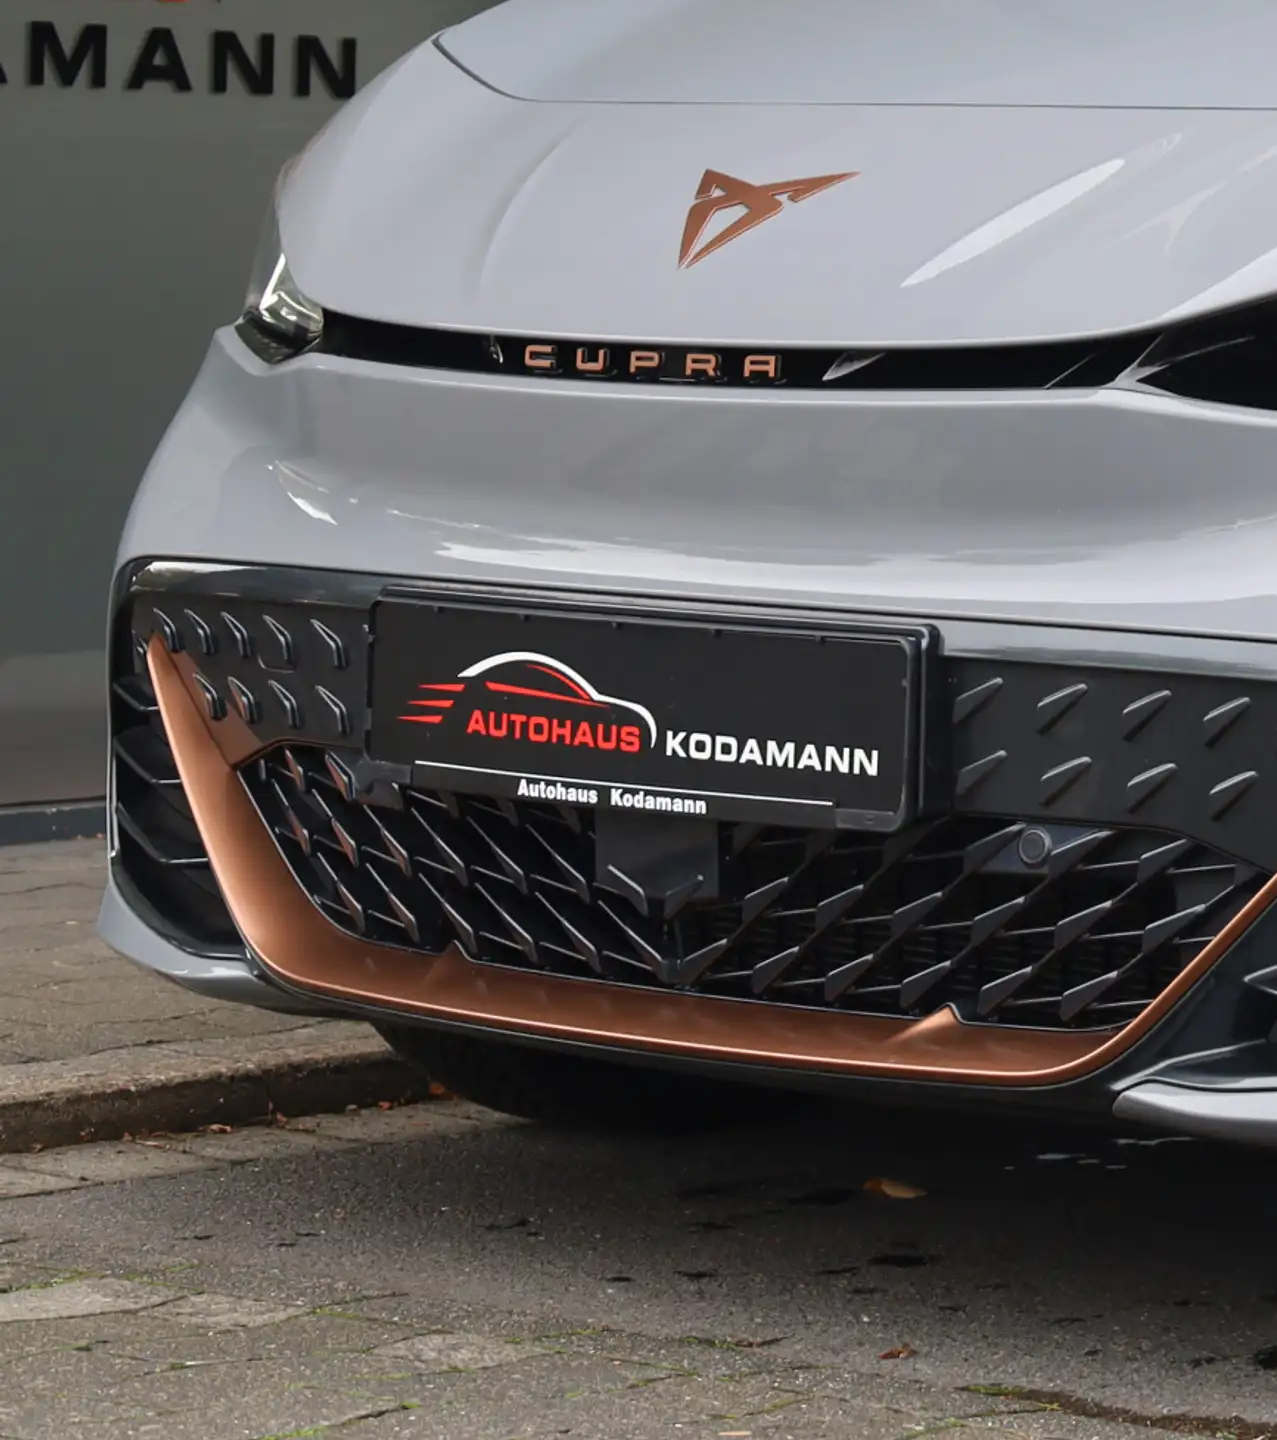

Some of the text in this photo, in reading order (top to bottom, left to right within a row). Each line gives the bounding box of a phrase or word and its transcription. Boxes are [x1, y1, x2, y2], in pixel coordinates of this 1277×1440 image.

[0, 20, 359, 100] MANN
[523, 343, 781, 379] CUPRA
[466, 708, 880, 777] AUTOHAUS KODAMANN
[517, 778, 708, 816] Autohaus Kodamann
